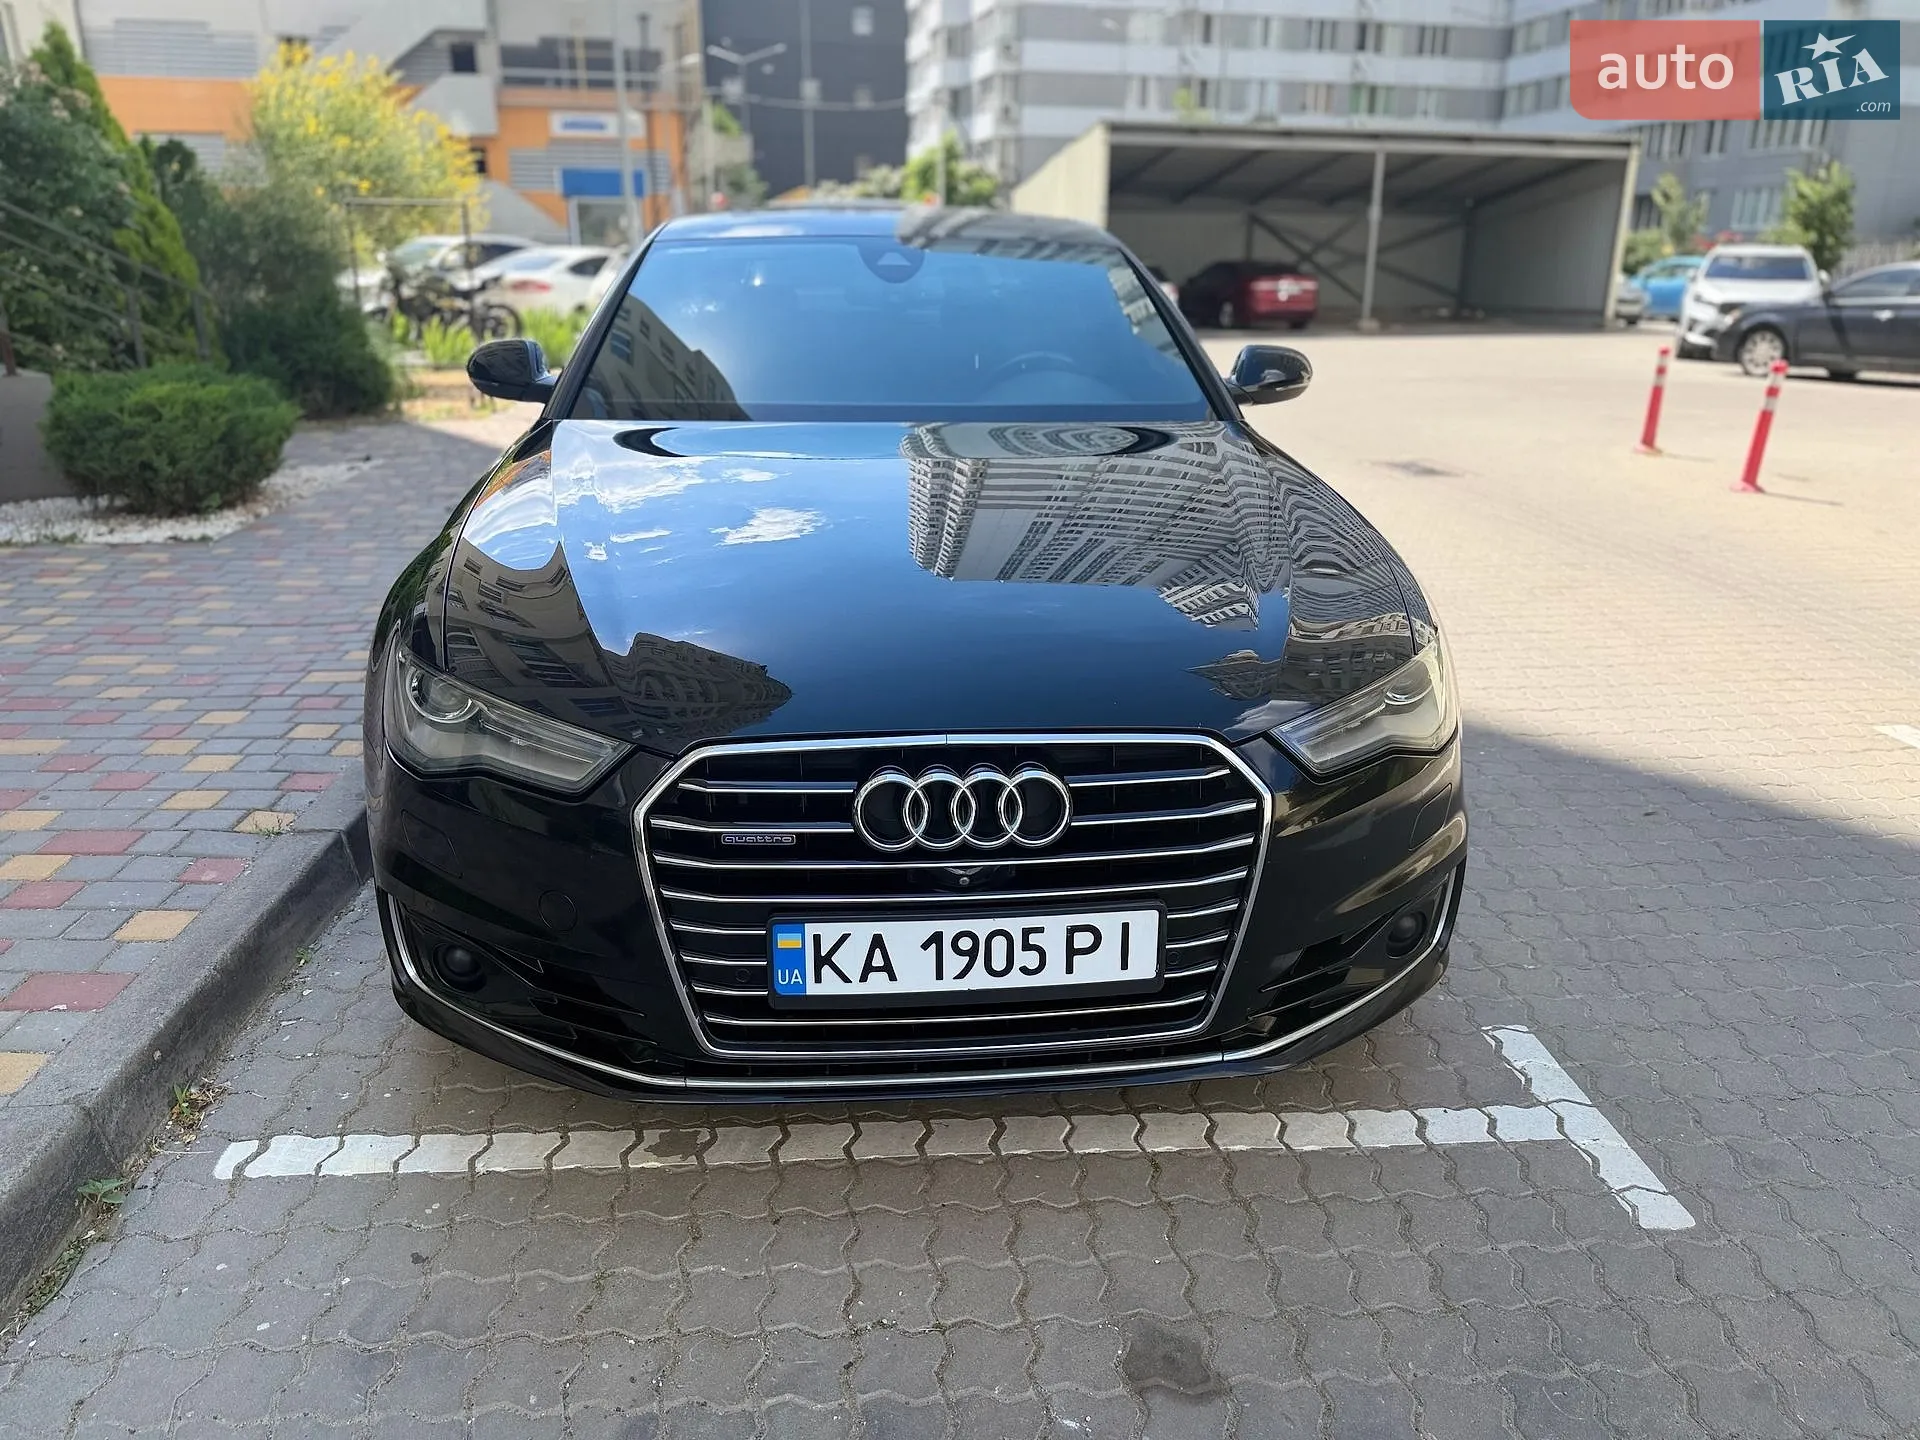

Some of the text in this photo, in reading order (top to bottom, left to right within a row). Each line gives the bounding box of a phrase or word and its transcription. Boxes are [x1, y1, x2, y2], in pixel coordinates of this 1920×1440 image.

[724, 835, 792, 844] quattro
[812, 921, 1130, 984] KA 1905 PI
[777, 968, 803, 985] UA
